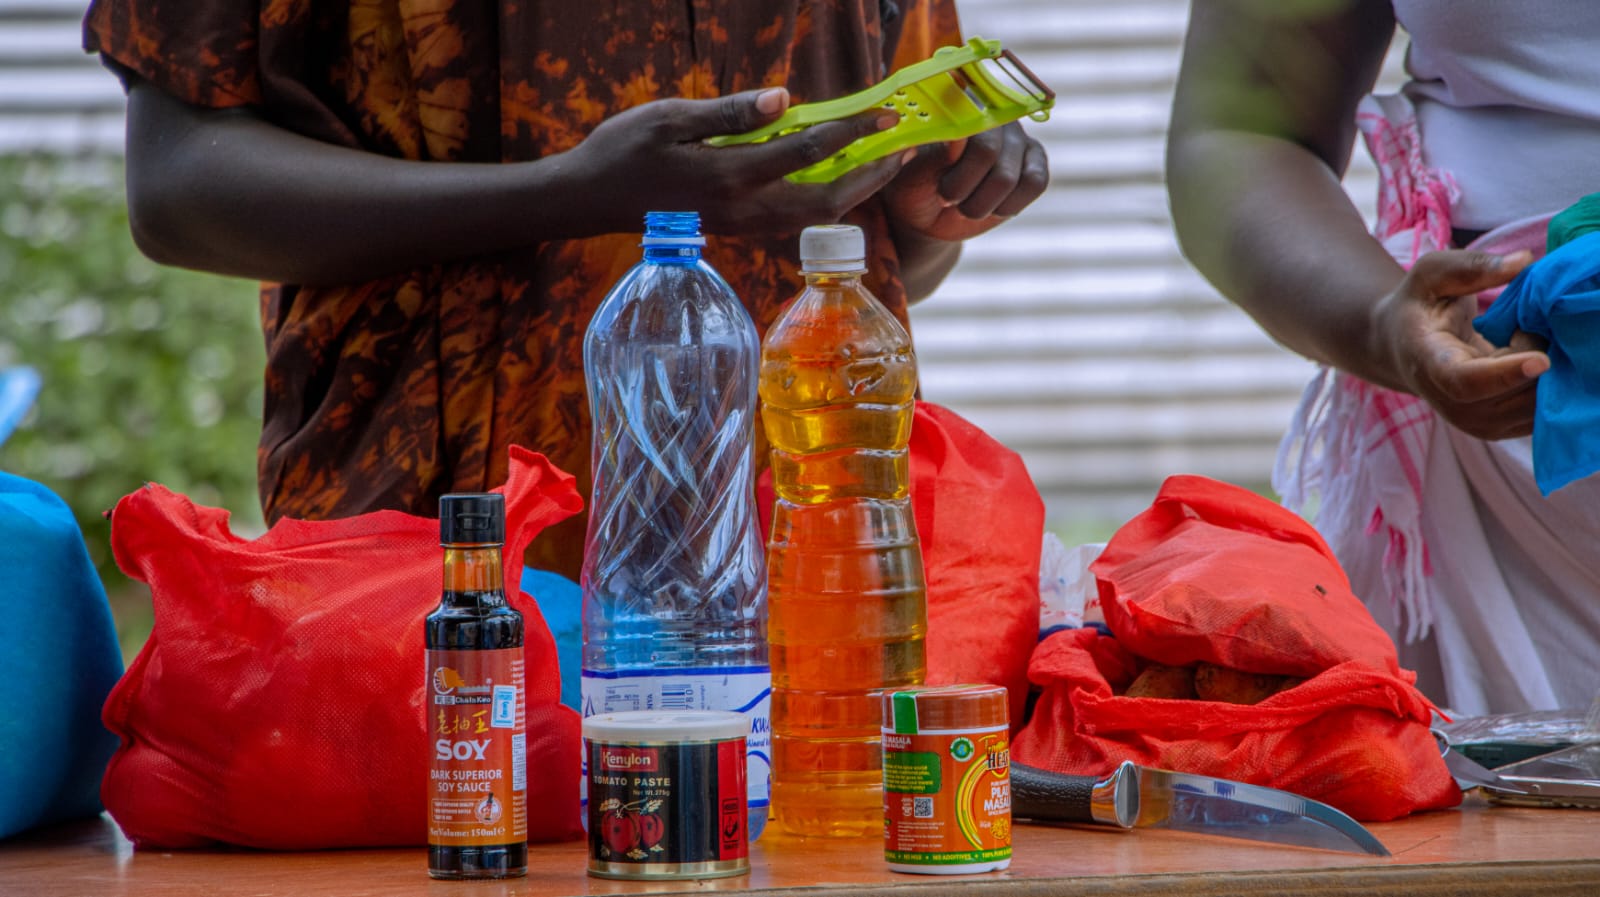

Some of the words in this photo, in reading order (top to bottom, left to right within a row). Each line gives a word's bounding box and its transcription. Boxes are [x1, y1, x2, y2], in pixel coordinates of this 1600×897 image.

[436, 709, 489, 734] 老抽王
[435, 738, 492, 761] SOY
[602, 752, 651, 768] Kenylon
[431, 770, 450, 779] DARK
[453, 769, 502, 780] SUPERIOR
[438, 782, 455, 792] SOY
[457, 781, 491, 792] SAUCE
[593, 775, 627, 786] TOMATO
[634, 777, 671, 787] PASTE
[471, 828, 496, 837] 150ml
